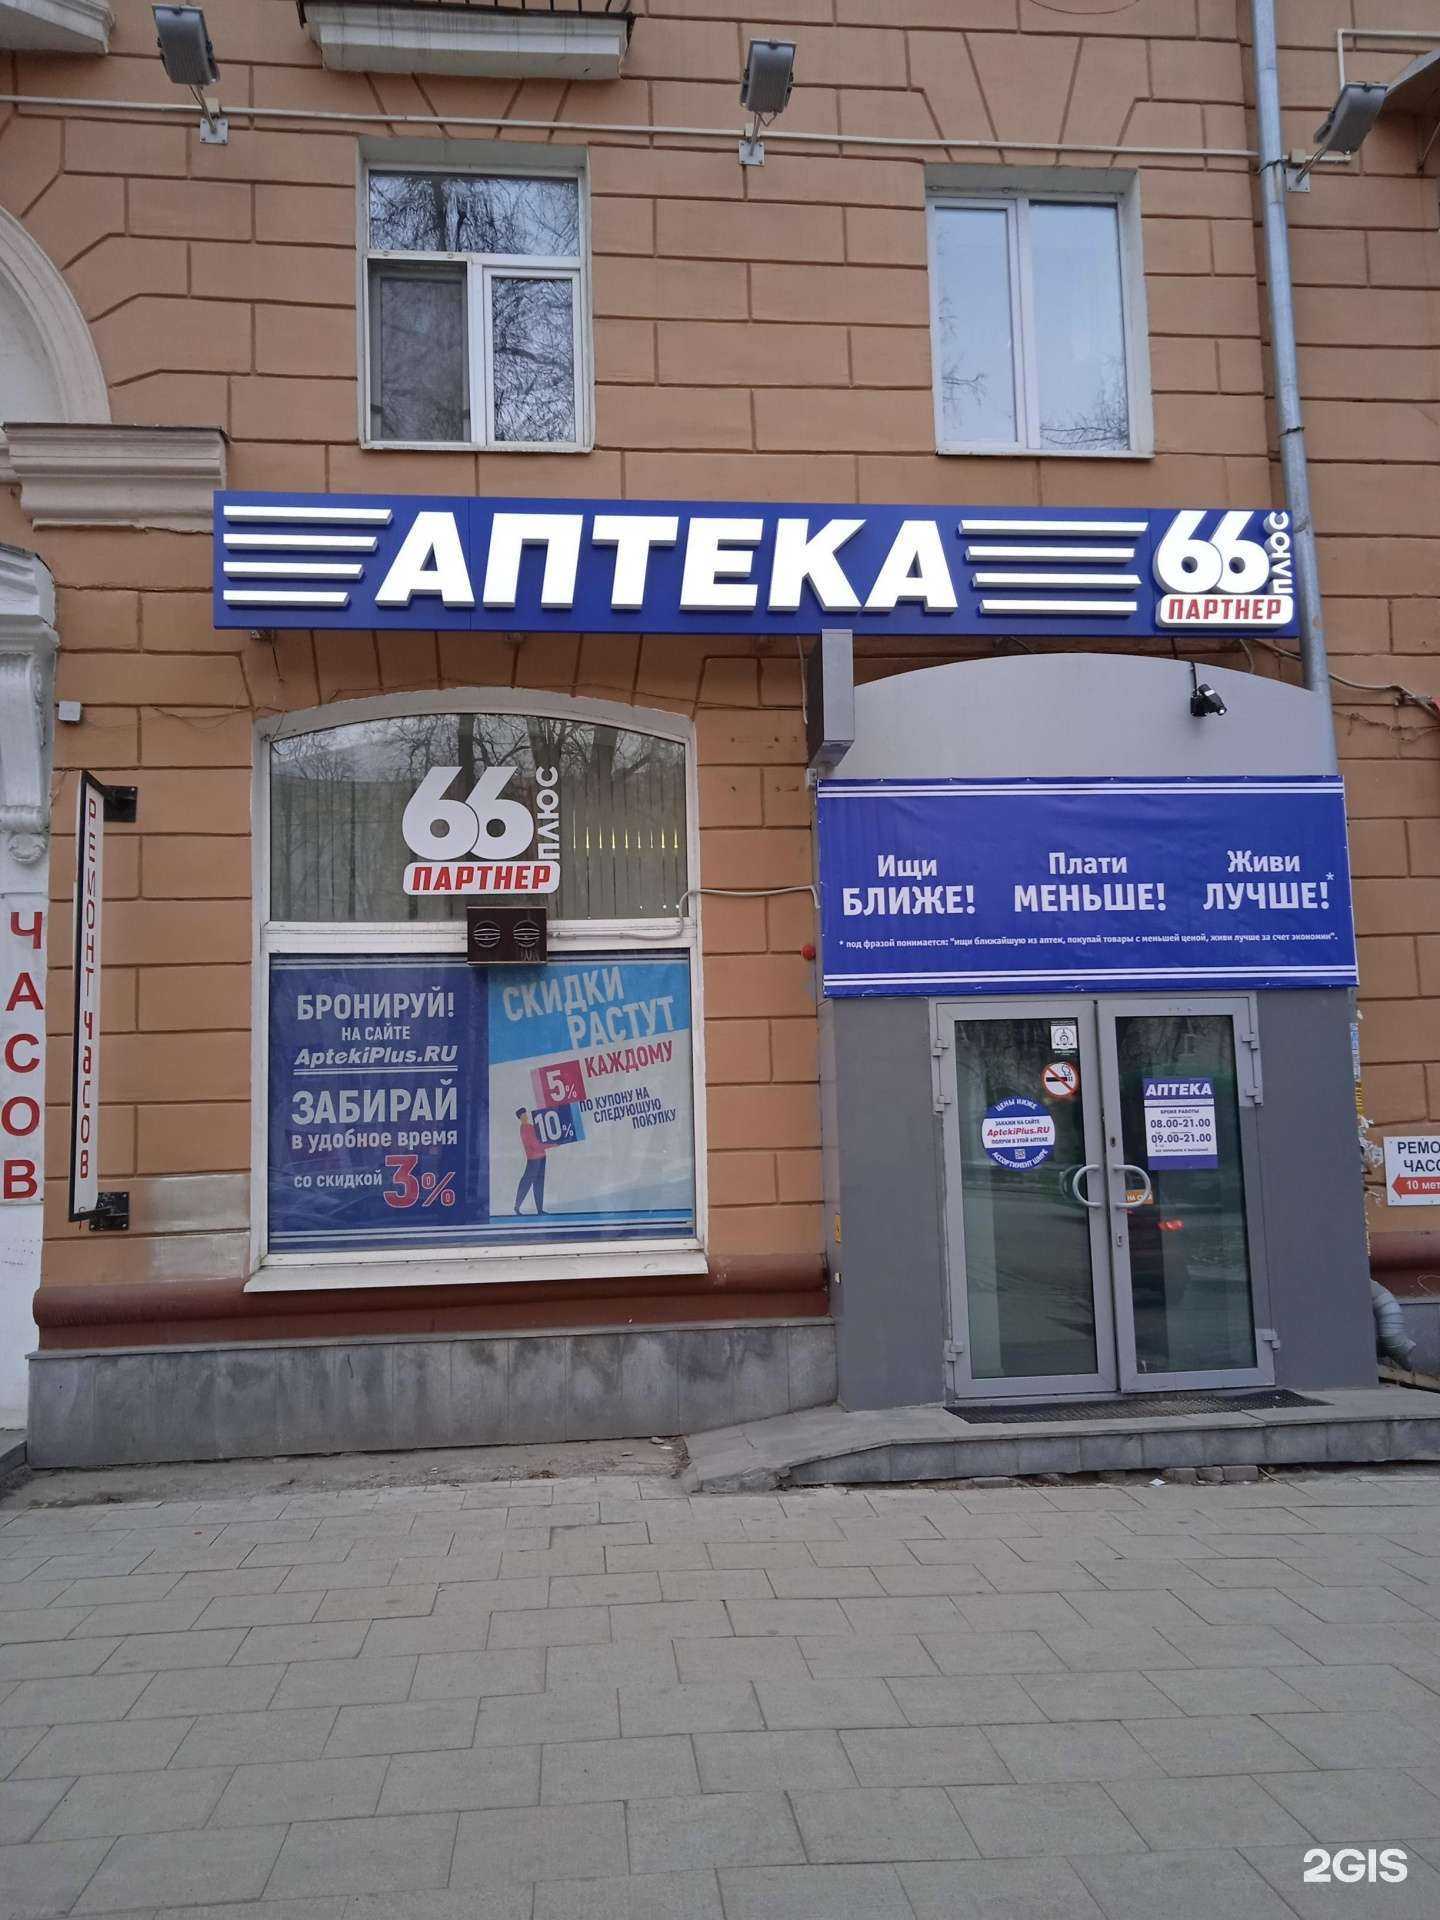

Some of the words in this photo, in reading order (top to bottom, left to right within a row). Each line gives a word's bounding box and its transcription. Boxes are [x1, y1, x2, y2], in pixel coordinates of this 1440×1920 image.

[374, 511, 958, 613] АПТЕКА
[1153, 510, 1270, 594] 66
[1264, 511, 1293, 594] ПЛЮС
[1168, 598, 1282, 620] ПАРТНЕР
[402, 766, 535, 860] 66
[535, 766, 560, 860] ПЛЮС
[877, 854, 938, 880] Ищи
[1048, 851, 1128, 876] Плати
[1227, 849, 1301, 873] Живи
[412, 865, 552, 891] ПАРТНЕР
[841, 884, 976, 917] БЛИЖЕ!
[1013, 882, 1167, 914] МЕНЬШЕ!
[846, 941, 862, 950] под
[863, 938, 895, 950] фразой
[896, 938, 949, 948] понимается:
[974, 936, 1026, 947] ближайшую
[1027, 937, 1038, 945] из
[1067, 934, 1101, 946] покупай
[1102, 935, 1134, 945] товары
[1142, 933, 1180, 943] меньшей
[1210, 934, 1233, 942] живи
[1234, 933, 1260, 943] лучше
[1261, 934, 1270, 942] за
[1272, 933, 1290, 941] счет
[297, 986, 455, 1020] БРОНИРУЙ!
[503, 966, 625, 1022] СКИДКИ
[341, 1027, 361, 1041] НА
[364, 1022, 411, 1041] САЙТЕ
[566, 996, 674, 1050] РАСТУТ
[1, 911, 43, 1199] ЧАСОВ
[294, 1045, 458, 1068] AptekiPlus.RU
[584, 1040, 673, 1078] КАЖДОМУ
[546, 1069, 577, 1102] 5%
[1146, 1083, 1212, 1097] АПТЕКА
[292, 1078, 457, 1125] ЗАБИРАЙ
[579, 1099, 594, 1113] ПО
[595, 1090, 634, 1109] КУПОНУ
[635, 1086, 650, 1101] НА
[593, 1098, 661, 1124] СЛЕДУЮЩУЮ
[533, 1110, 574, 1143] 10%
[632, 1109, 676, 1129] ПОКУПКУ
[987, 1126, 1050, 1138] AptekiPlus.RU
[1150, 1118, 1211, 1129] 08.00-21.00
[292, 1134, 302, 1149] в
[308, 1128, 392, 1154] удобное
[397, 1130, 458, 1151] время
[1151, 1133, 1212, 1143] 09.00-21.00
[294, 1175, 312, 1188] со
[316, 1169, 383, 1189] скидкой
[383, 1154, 456, 1208] 3%
[1406, 1180, 1419, 1190] 10
